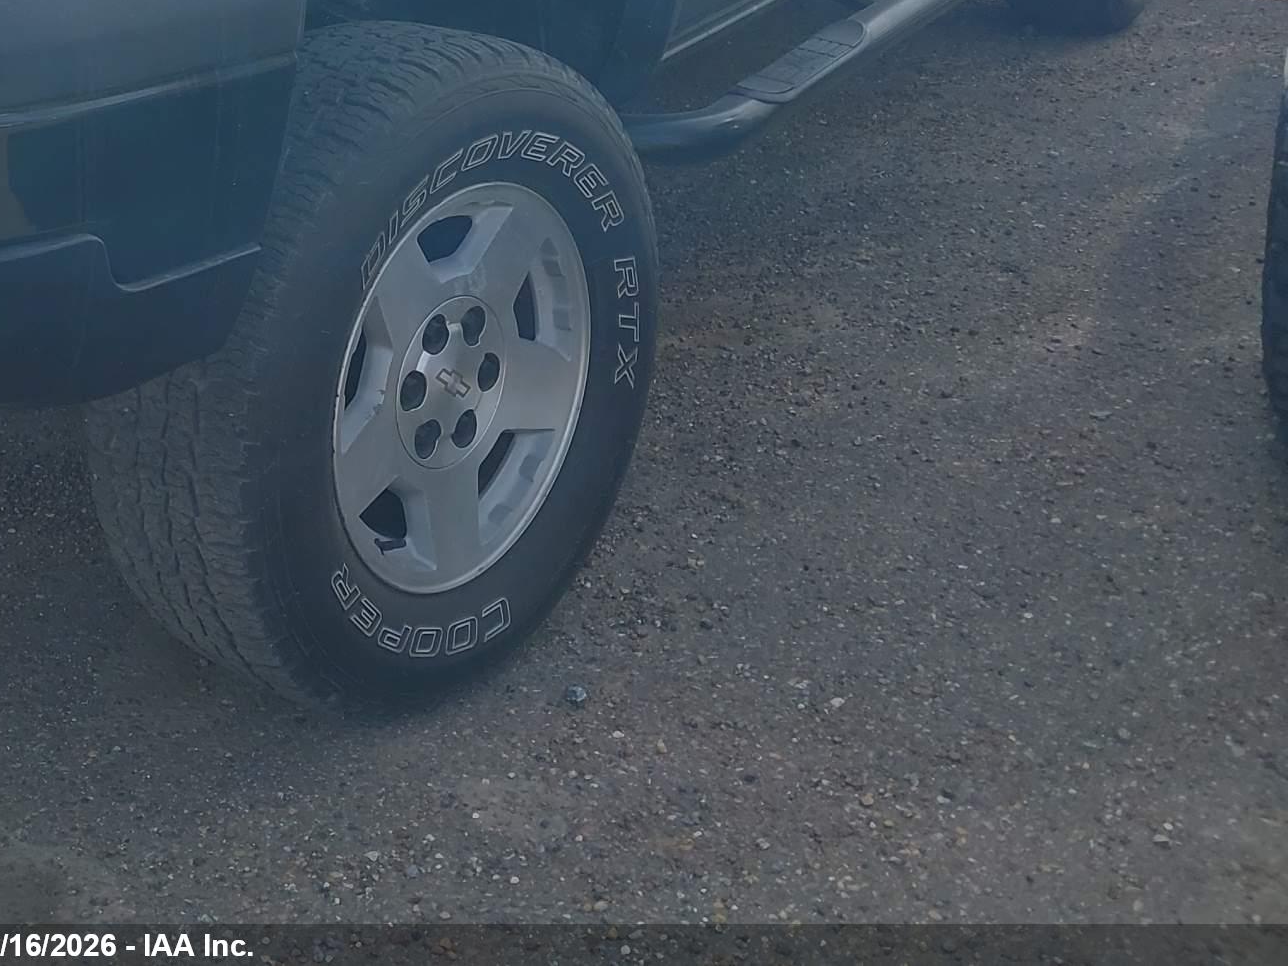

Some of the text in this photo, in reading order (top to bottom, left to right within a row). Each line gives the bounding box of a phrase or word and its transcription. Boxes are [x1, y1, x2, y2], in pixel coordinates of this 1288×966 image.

[361, 130, 640, 389] DISCOVERER RTX
[331, 562, 511, 658] COOPER
